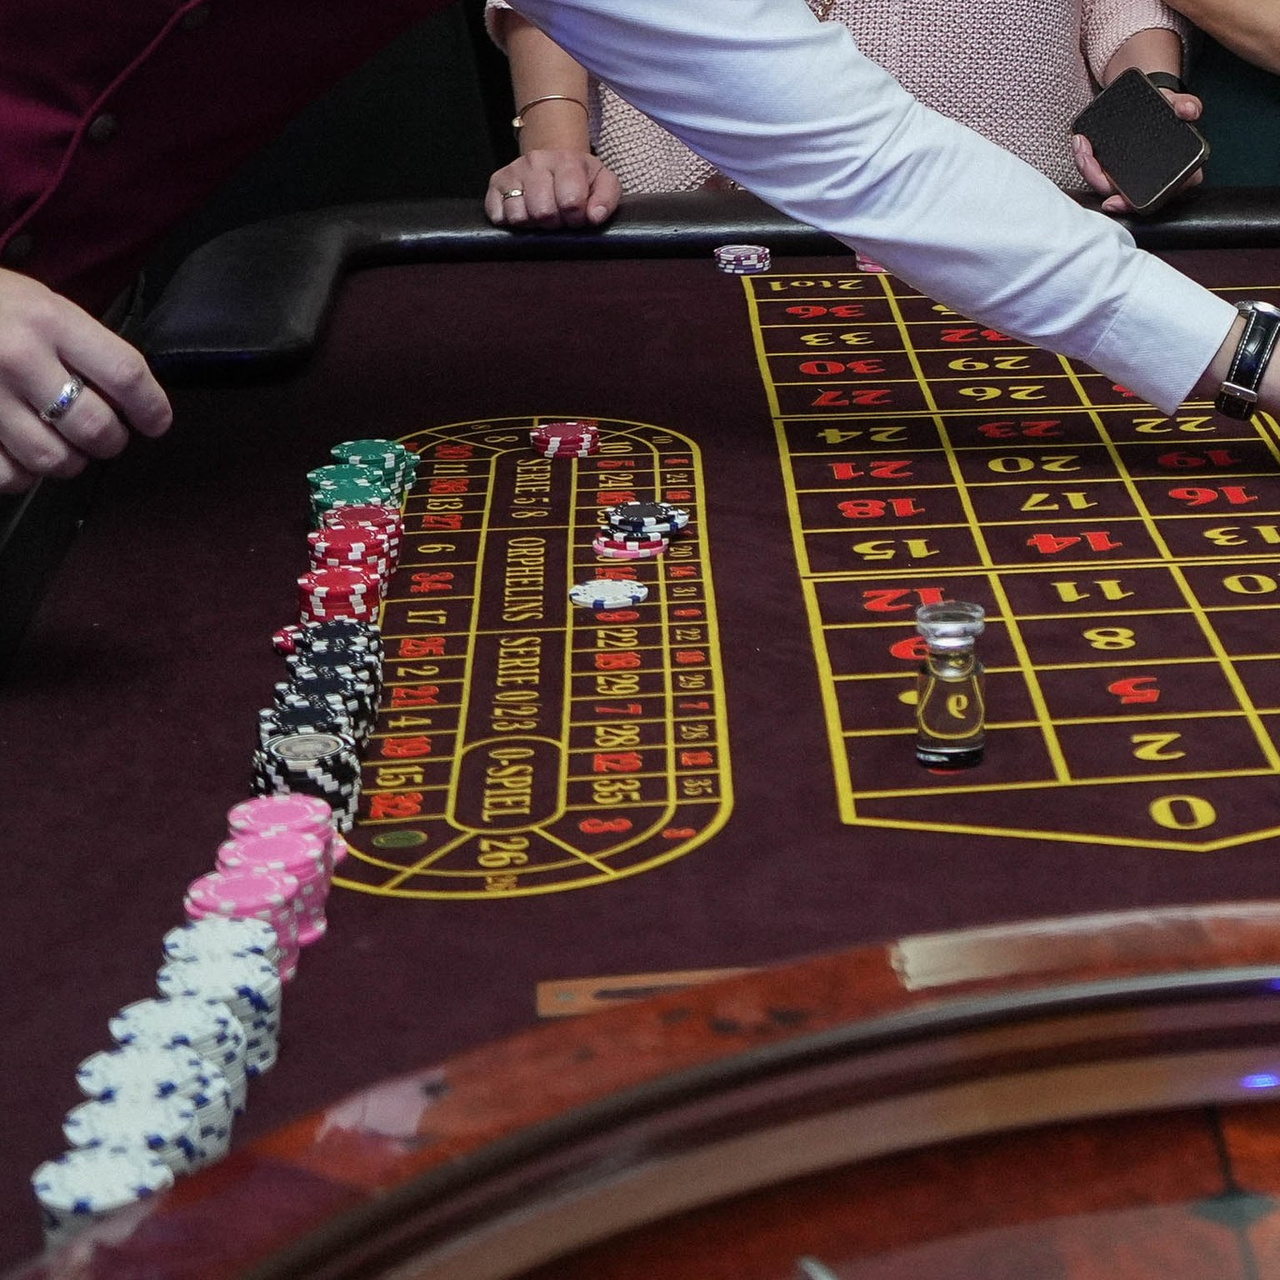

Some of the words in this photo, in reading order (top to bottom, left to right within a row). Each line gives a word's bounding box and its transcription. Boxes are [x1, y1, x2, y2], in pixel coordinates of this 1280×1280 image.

[785, 304, 867, 319] 36
[799, 331, 875, 346] 33
[799, 359, 887, 376] 30
[947, 356, 1032, 371] 29
[811, 389, 893, 407] 27
[957, 385, 1048, 402] 26
[816, 426, 908, 444] 24
[977, 420, 1061, 438] 23
[1132, 416, 1217, 434] 22
[987, 455, 1082, 473] 20
[1157, 449, 1242, 468] 19
[514, 458, 552, 495] SERIE
[828, 460, 914, 480] 21
[599, 473, 634, 488] 24
[427, 498, 463, 510] 13
[1020, 491, 1099, 512] 17
[1168, 485, 1259, 507] 16
[836, 497, 926, 519] 18
[417, 543, 456, 553] 6
[852, 539, 940, 561] 15
[1025, 531, 1123, 554] 14
[502, 536, 547, 622] ORPHELINS
[861, 586, 955, 612] 12
[1050, 579, 1135, 603] 11
[406, 609, 448, 625] 17
[596, 628, 639, 648] 22
[1082, 626, 1137, 651] 8
[397, 665, 440, 677] 2
[495, 636, 542, 687] SERIE
[596, 674, 640, 695] 29
[1107, 677, 1161, 705] 5
[388, 716, 432, 728] 4
[594, 724, 640, 748] 28
[1130, 732, 1187, 761] 2
[375, 765, 425, 787] 15
[592, 779, 641, 805] 35
[1148, 793, 1218, 831] 0
[478, 836, 530, 868] 26
